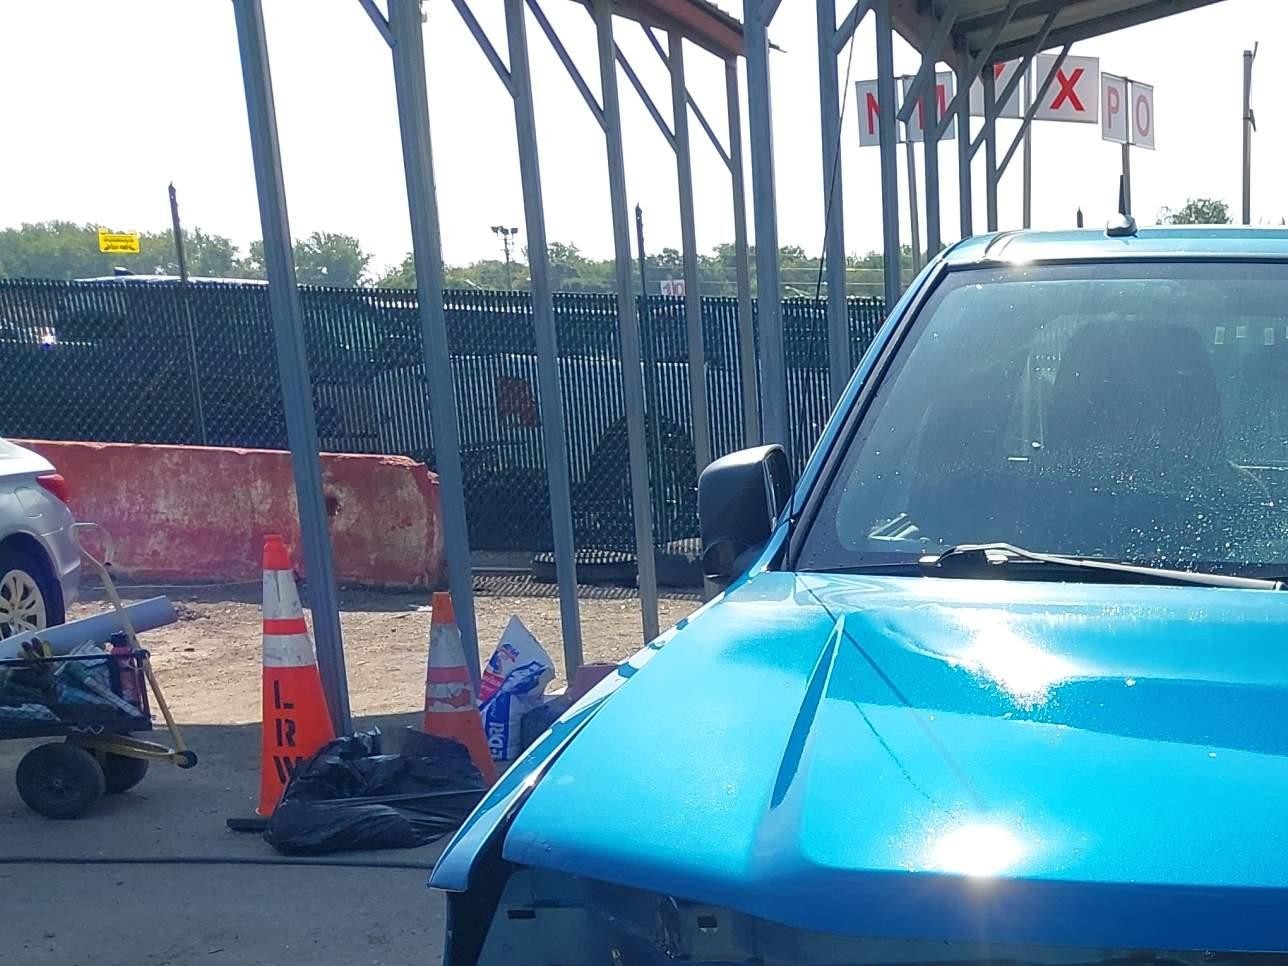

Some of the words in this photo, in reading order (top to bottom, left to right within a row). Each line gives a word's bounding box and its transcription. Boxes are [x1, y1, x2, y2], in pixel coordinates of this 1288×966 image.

[1050, 68, 1085, 112] X
[1107, 86, 1120, 130] P
[1136, 94, 1150, 137] O
